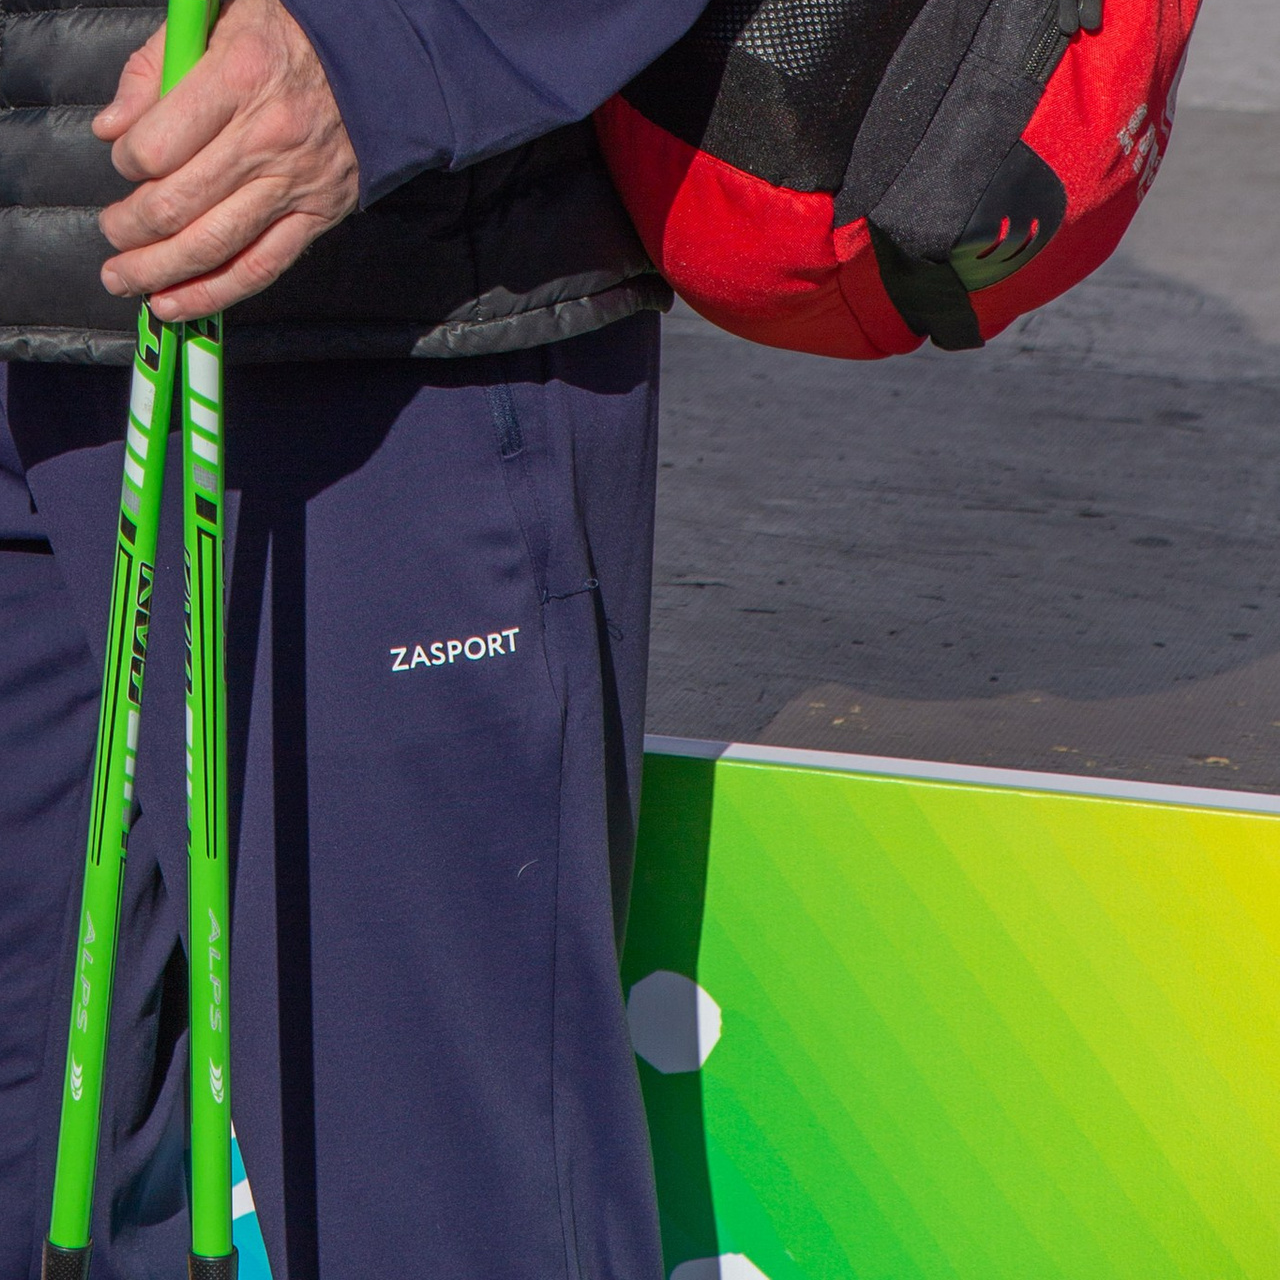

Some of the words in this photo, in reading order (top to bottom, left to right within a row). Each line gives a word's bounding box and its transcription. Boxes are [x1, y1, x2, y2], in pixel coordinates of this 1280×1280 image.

[389, 627, 520, 672] ZASPORT
[75, 910, 96, 1035] ALPS
[208, 908, 222, 1033] ALPS
